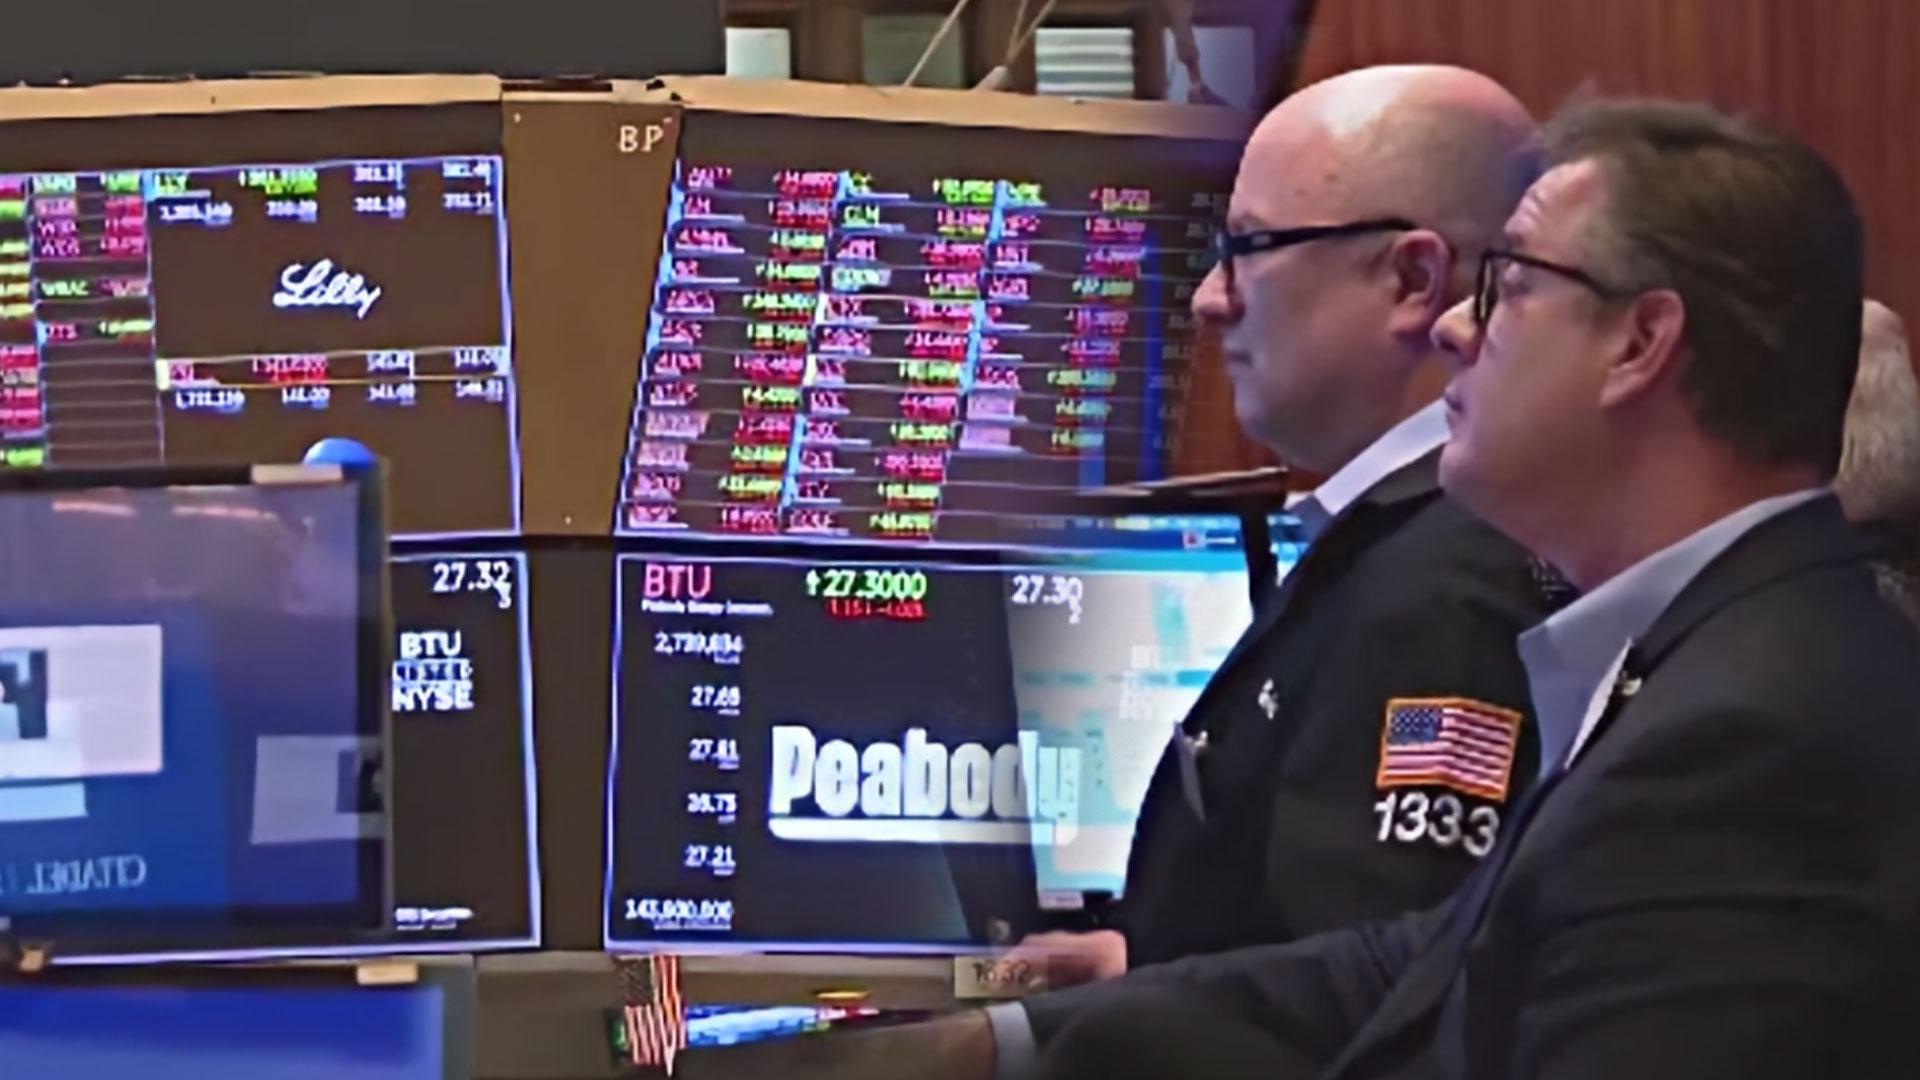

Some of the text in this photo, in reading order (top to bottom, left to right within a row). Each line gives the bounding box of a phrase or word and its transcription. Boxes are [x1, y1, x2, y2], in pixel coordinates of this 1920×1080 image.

[273, 258, 381, 320] Lilly
[433, 561, 511, 593] 27.32
[643, 563, 711, 599] BTU
[823, 570, 928, 600] 27.3000
[1012, 575, 1083, 604] 27.30
[400, 630, 462, 658] BTU
[391, 682, 474, 712] NYSE
[769, 724, 1081, 846] Peabody
[1374, 791, 1500, 857] 1333
